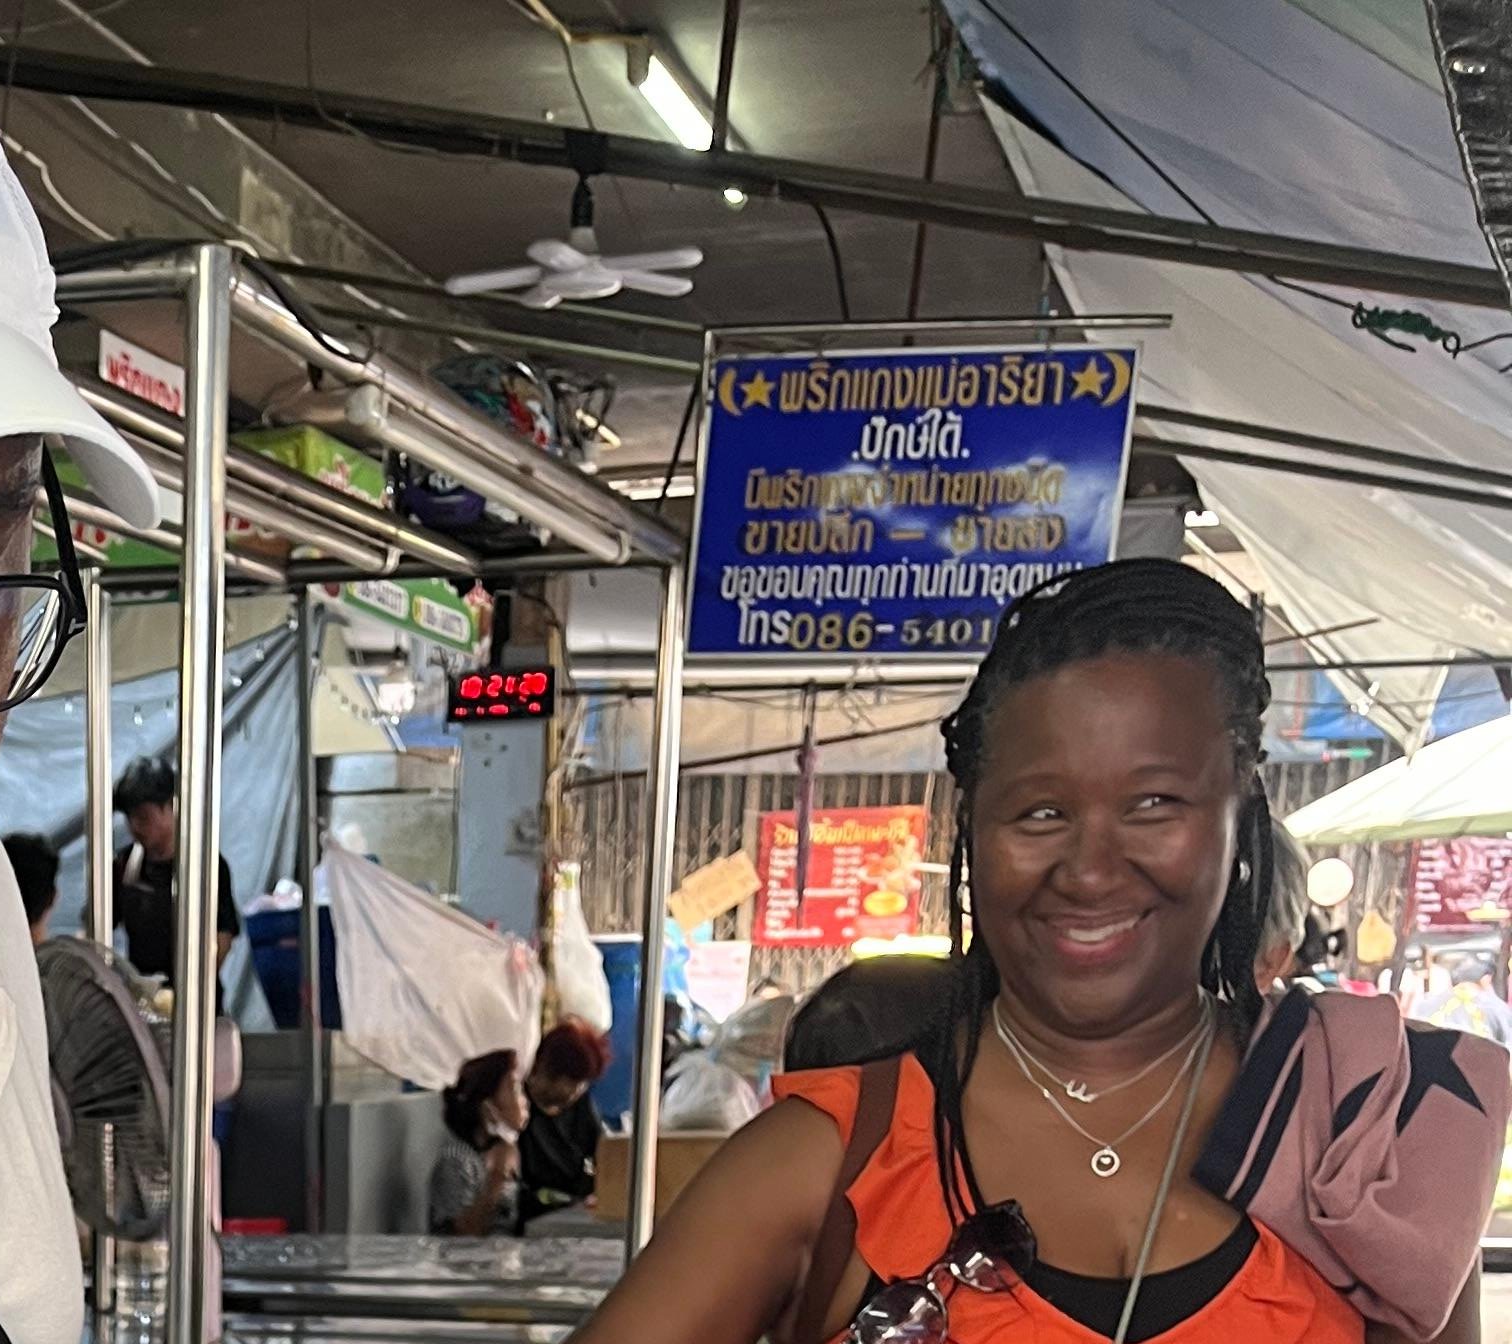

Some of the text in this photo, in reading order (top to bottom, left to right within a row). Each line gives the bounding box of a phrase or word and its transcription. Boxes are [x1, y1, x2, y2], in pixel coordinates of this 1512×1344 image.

[779, 355, 1066, 413] พริกแกงแม่อาริยา
